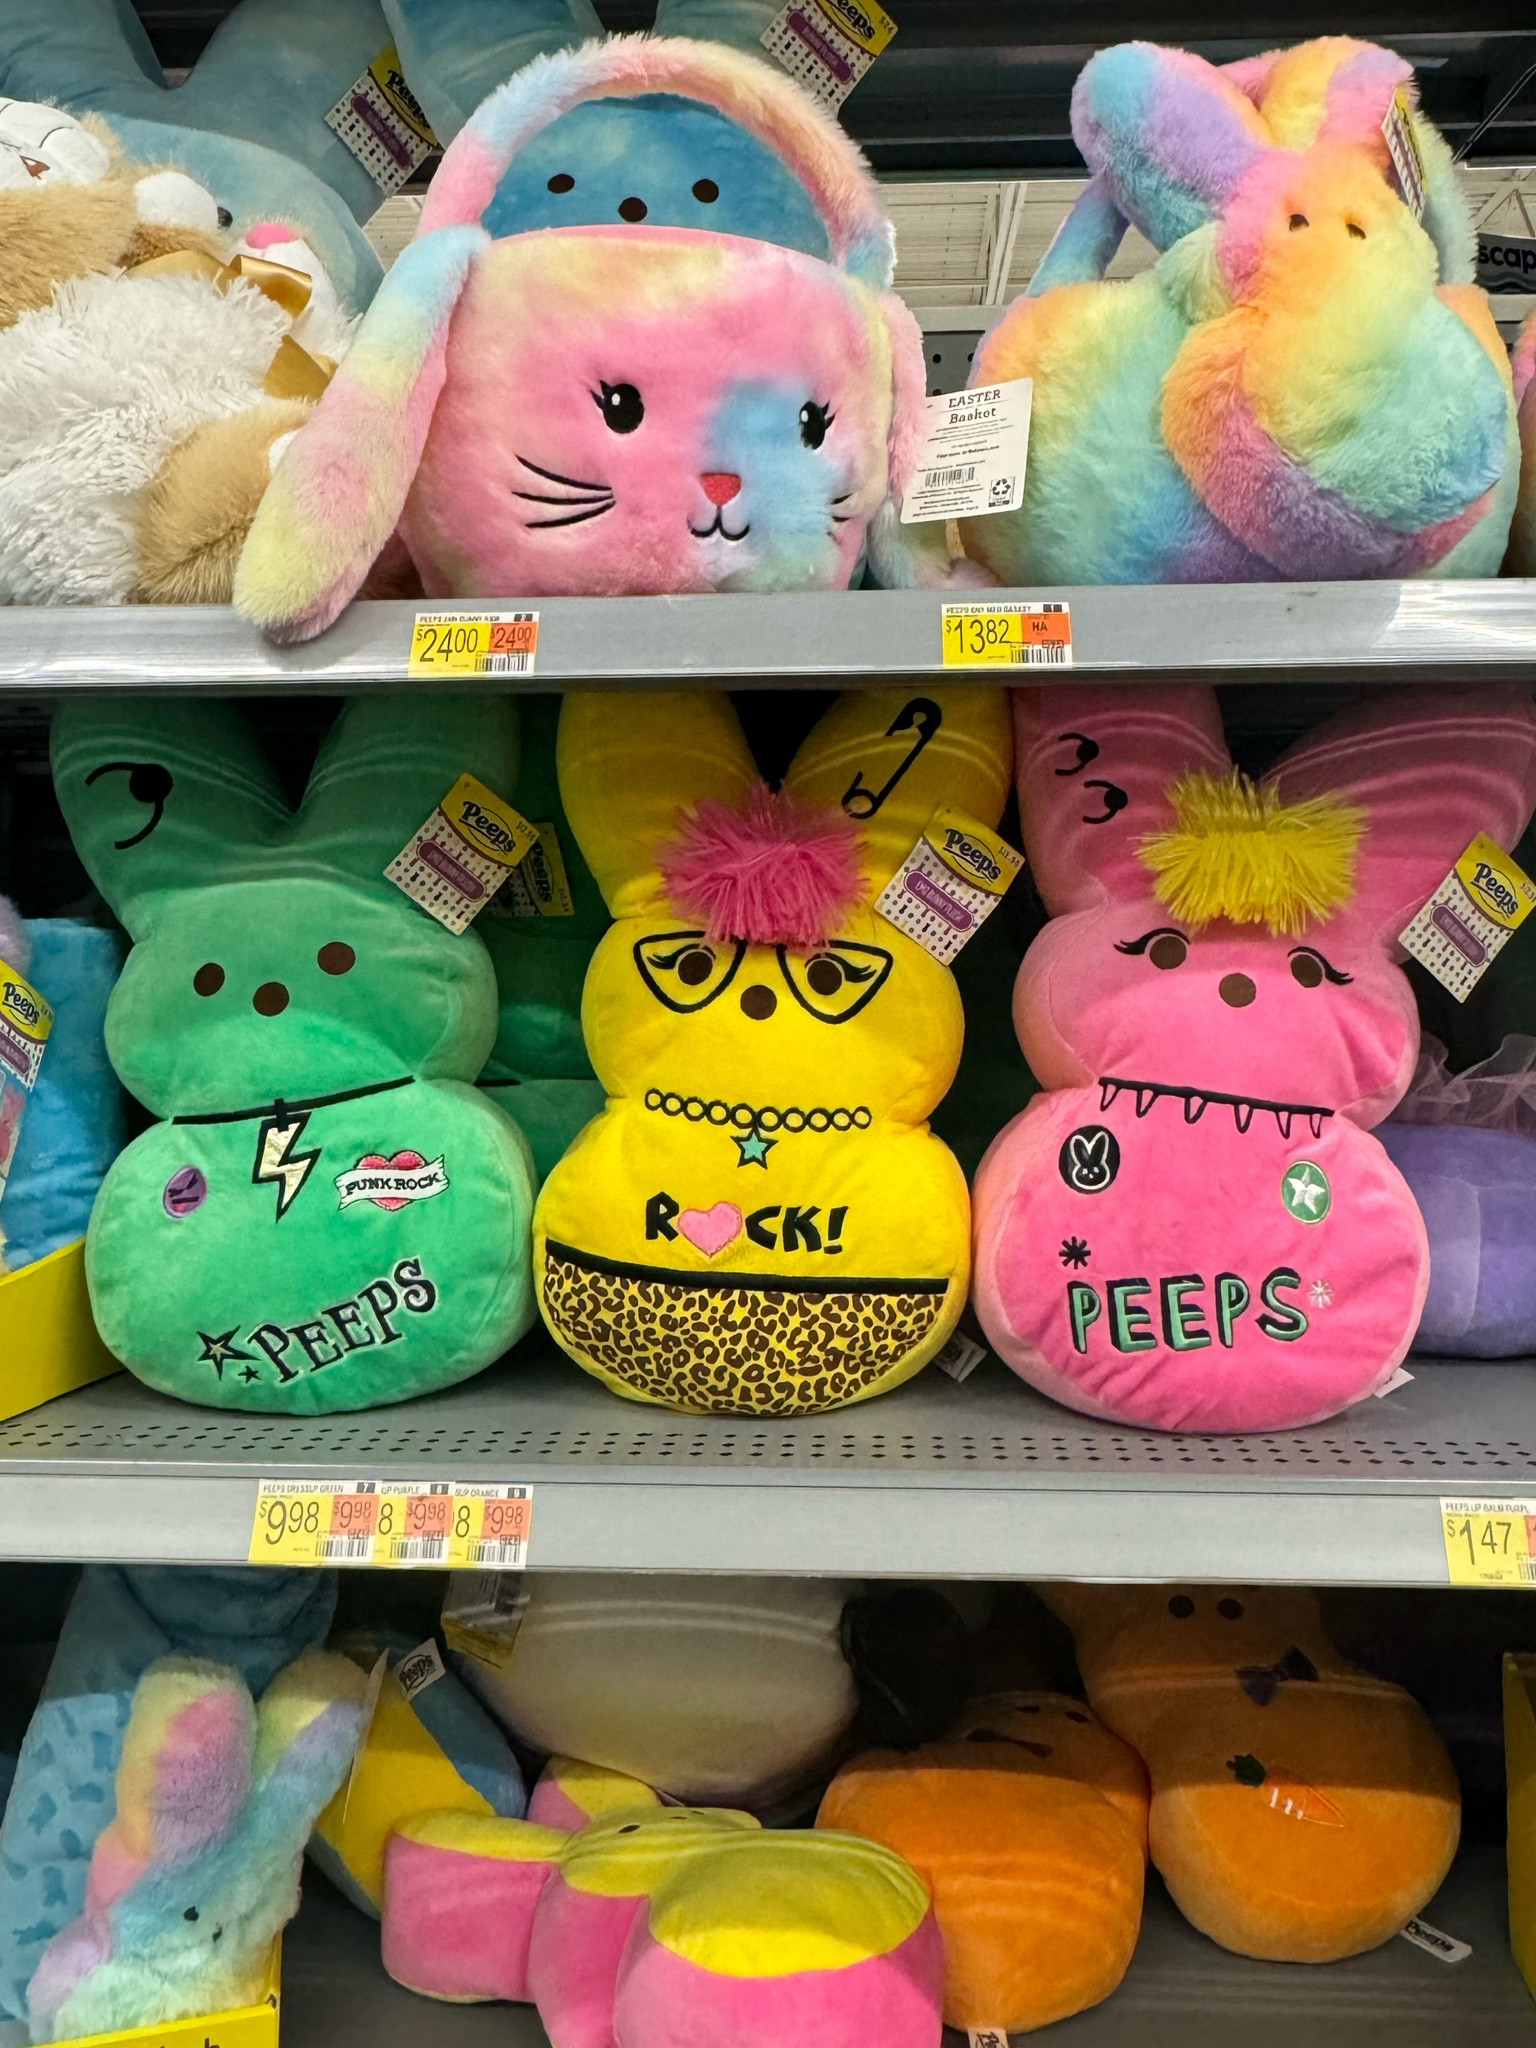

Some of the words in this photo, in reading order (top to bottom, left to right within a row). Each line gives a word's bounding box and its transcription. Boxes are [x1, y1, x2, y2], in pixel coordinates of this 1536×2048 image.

[837, 0, 876, 40] eeps
[948, 389, 1001, 408] EASTER
[459, 801, 517, 853] Peeps
[943, 829, 1001, 881] Peeps
[1471, 862, 1519, 916] Peeps
[3, 982, 40, 1025] Peeps
[345, 1177, 393, 1196] PUNK
[393, 1172, 441, 1190] ROCK
[247, 1256, 437, 1383] PEEPS
[1066, 1266, 1309, 1354] PEEPS
[399, 1654, 434, 1688] Peeps
